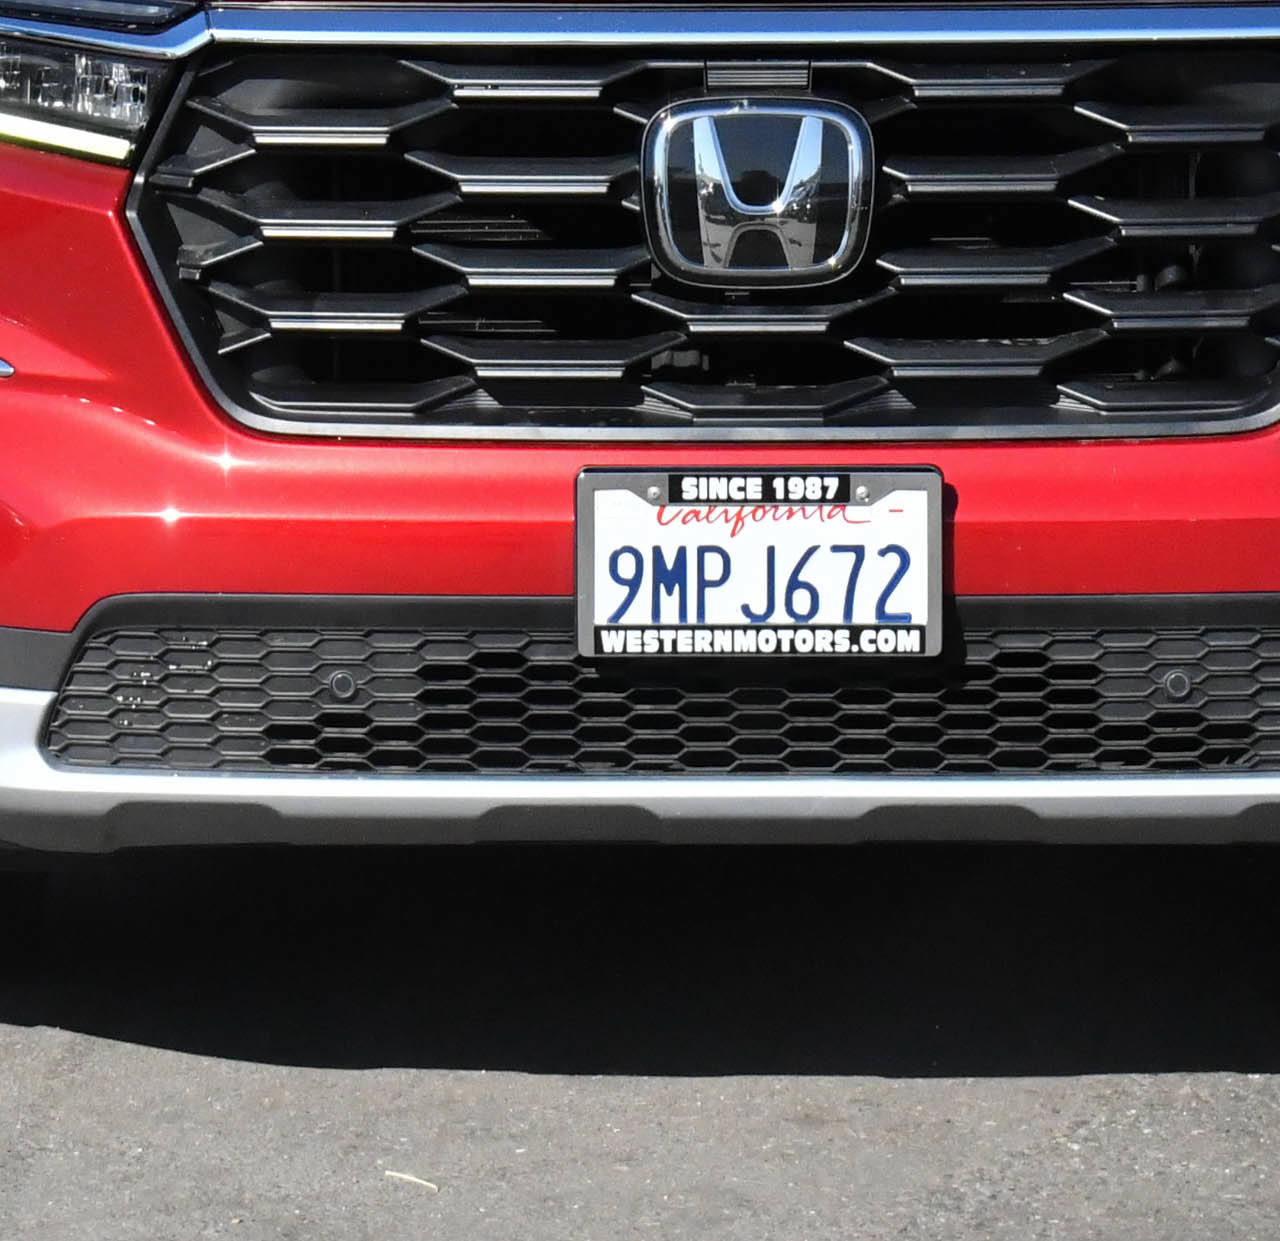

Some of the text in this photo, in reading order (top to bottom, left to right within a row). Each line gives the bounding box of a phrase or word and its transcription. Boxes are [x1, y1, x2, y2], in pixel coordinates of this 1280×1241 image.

[680, 476, 839, 501] SINCE 1987
[656, 505, 873, 538] California
[607, 544, 913, 624] 9MPJ672
[600, 629, 921, 654] WESTERNMOTORS.COM
